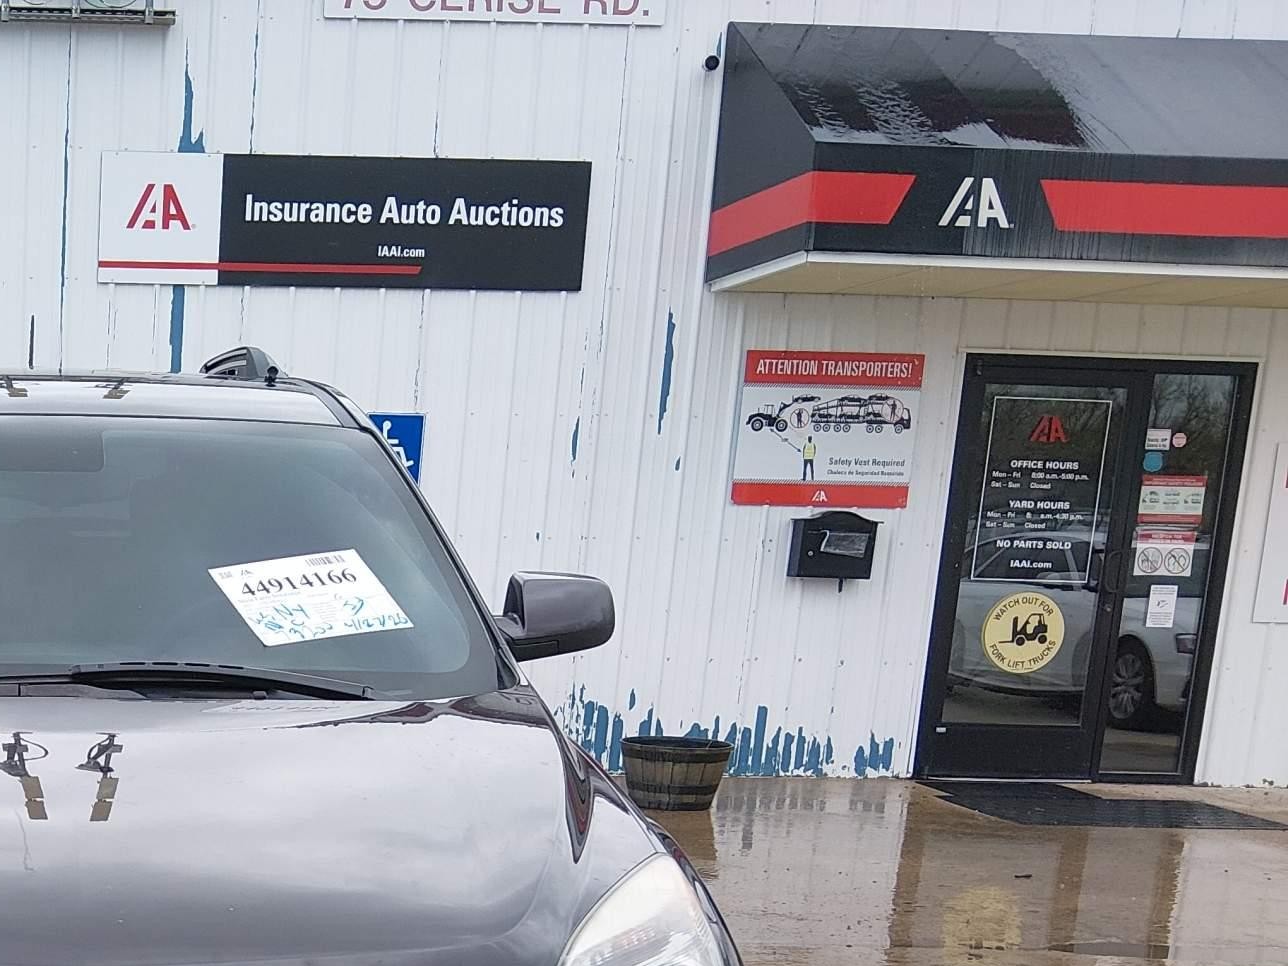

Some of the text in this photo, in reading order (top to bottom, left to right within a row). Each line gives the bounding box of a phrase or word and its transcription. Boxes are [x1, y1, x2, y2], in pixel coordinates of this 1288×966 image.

[244, 193, 564, 228] Insurance Auto Auctions
[377, 246, 425, 259] IAAI.com
[756, 359, 912, 378] ATTENTION TRANSPORTERS!
[828, 456, 905, 468] Safety Vest Required
[1010, 460, 1079, 470] OFFICE HOURS
[1009, 500, 1070, 510] YARD HOURS
[996, 539, 1072, 550] NO PARTS SOLD
[1010, 559, 1052, 568] IAAI.com
[240, 567, 357, 597] 44914166
[993, 596, 1054, 620] WATCH OUT FOR
[989, 639, 1056, 669] FORK LIFT TRUCKS
